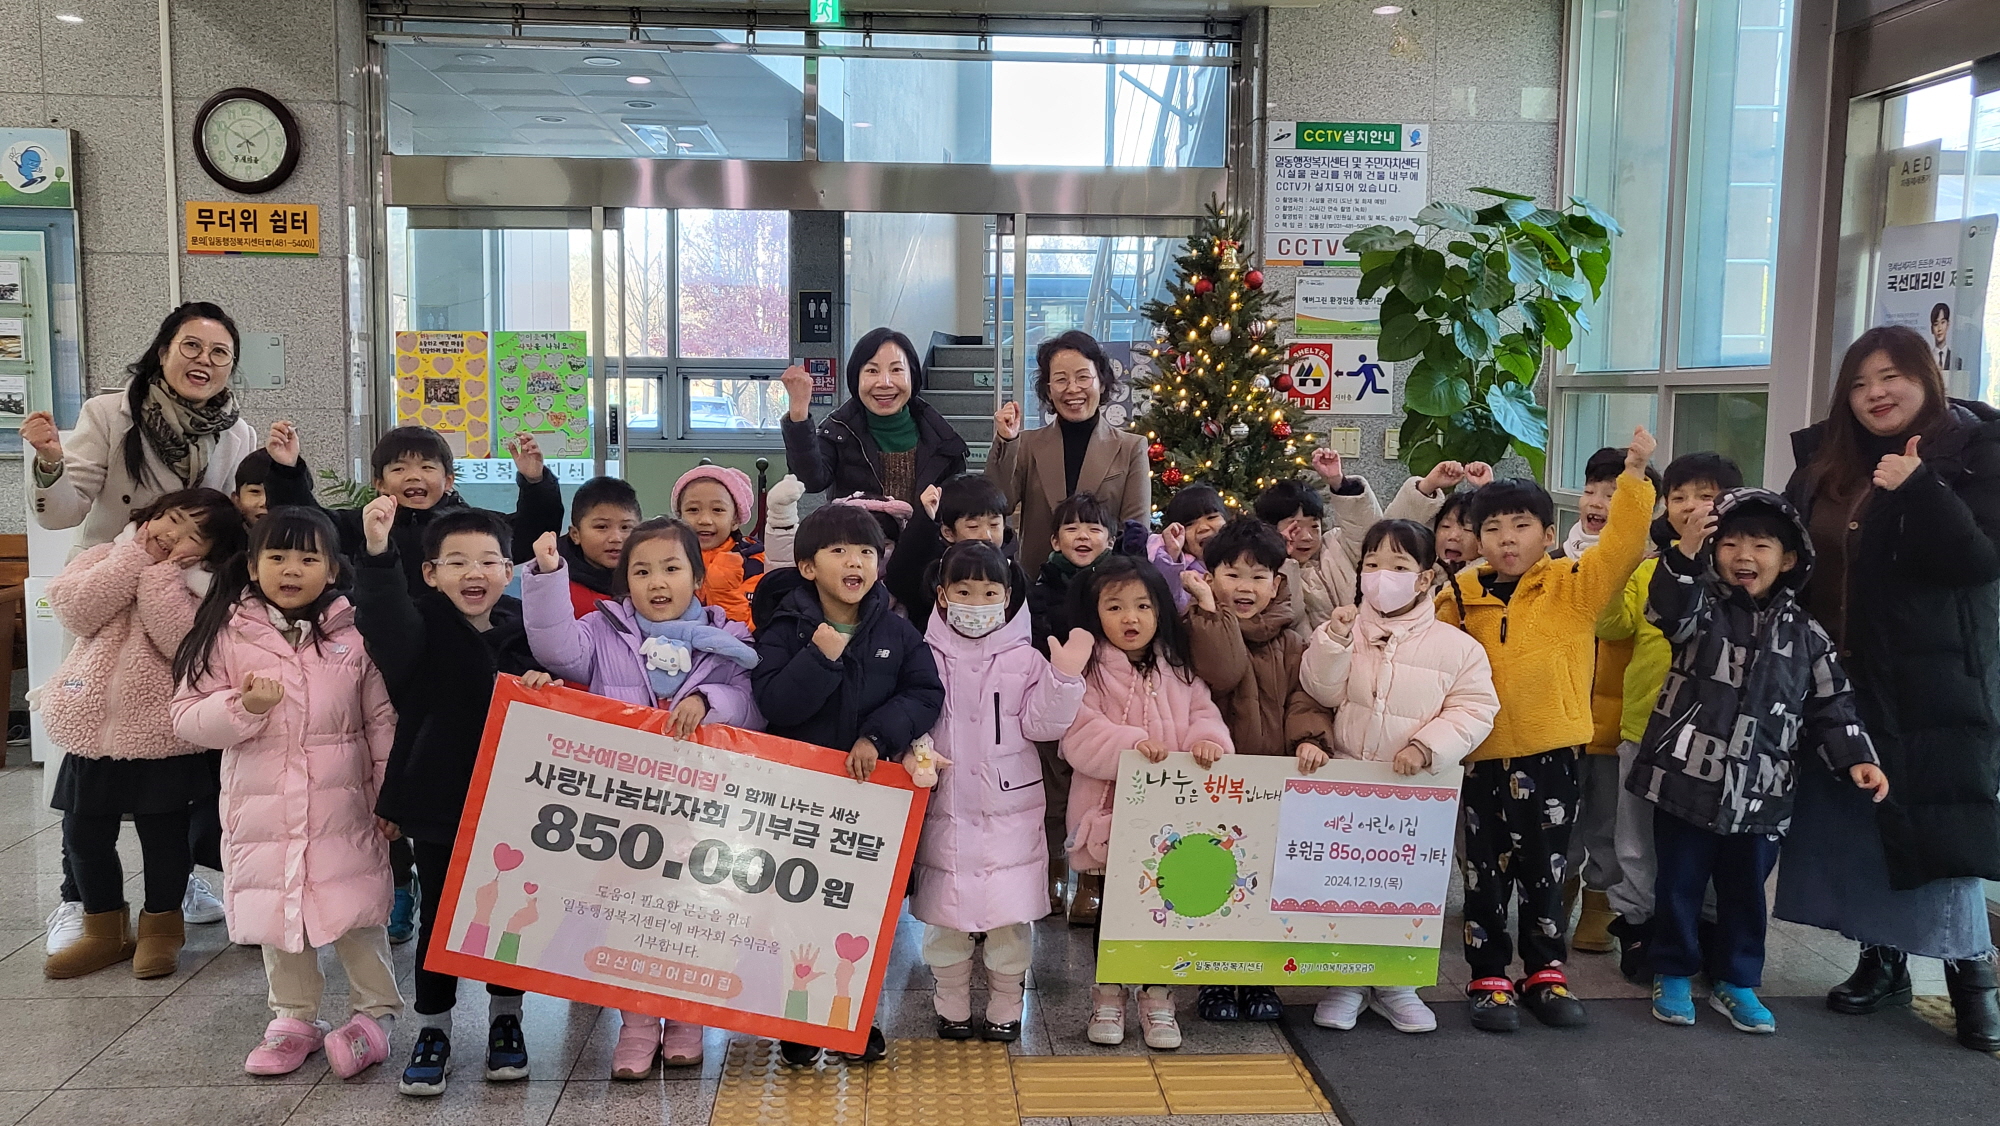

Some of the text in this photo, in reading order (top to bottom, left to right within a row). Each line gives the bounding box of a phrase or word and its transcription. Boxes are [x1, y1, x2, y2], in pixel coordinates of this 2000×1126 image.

[1303, 129, 1395, 144] CCTV설치안내
[1275, 156, 1420, 170] 일동행정복지센터 및 주민자치센터
[1901, 156, 1932, 175] AED
[1277, 170, 1419, 181] 시설물 관리를 위해 건물 내부에
[1276, 182, 1401, 193] CCTV가 설치되어 있습니다.
[196, 209, 307, 234] 무더위 쉼터
[1278, 238, 1340, 256] CCTV
[1887, 271, 1946, 292] 국선대리인
[1302, 296, 1328, 305] 에버그린
[1330, 296, 1355, 306] 환경인증
[1293, 347, 1330, 360] SHELTER
[812, 376, 835, 388] 화전
[1289, 397, 1330, 409] 대피소
[673, 745, 774, 775] WITH LOVE
[1146, 769, 1199, 805] 나눔은
[524, 760, 885, 862] 사랑나눔바자회 기부금 전달
[745, 787, 777, 807] 함께
[780, 796, 825, 818] 나누는
[829, 806, 860, 825] 세상
[1324, 812, 1419, 837] 예일 어린이집
[1285, 839, 1448, 866] 후원금 850,000원 기탁
[1324, 875, 1403, 890] 2024.12.19.(목)
[595, 885, 636, 905] 도움이
[640, 894, 681, 913] 필요한
[682, 902, 723, 923] 분들을
[633, 933, 700, 959] 기부합니다.
[686, 925, 726, 943] 바자회
[728, 933, 781, 955] 수익금을
[1195, 961, 1264, 972] 일동행정복지센터
